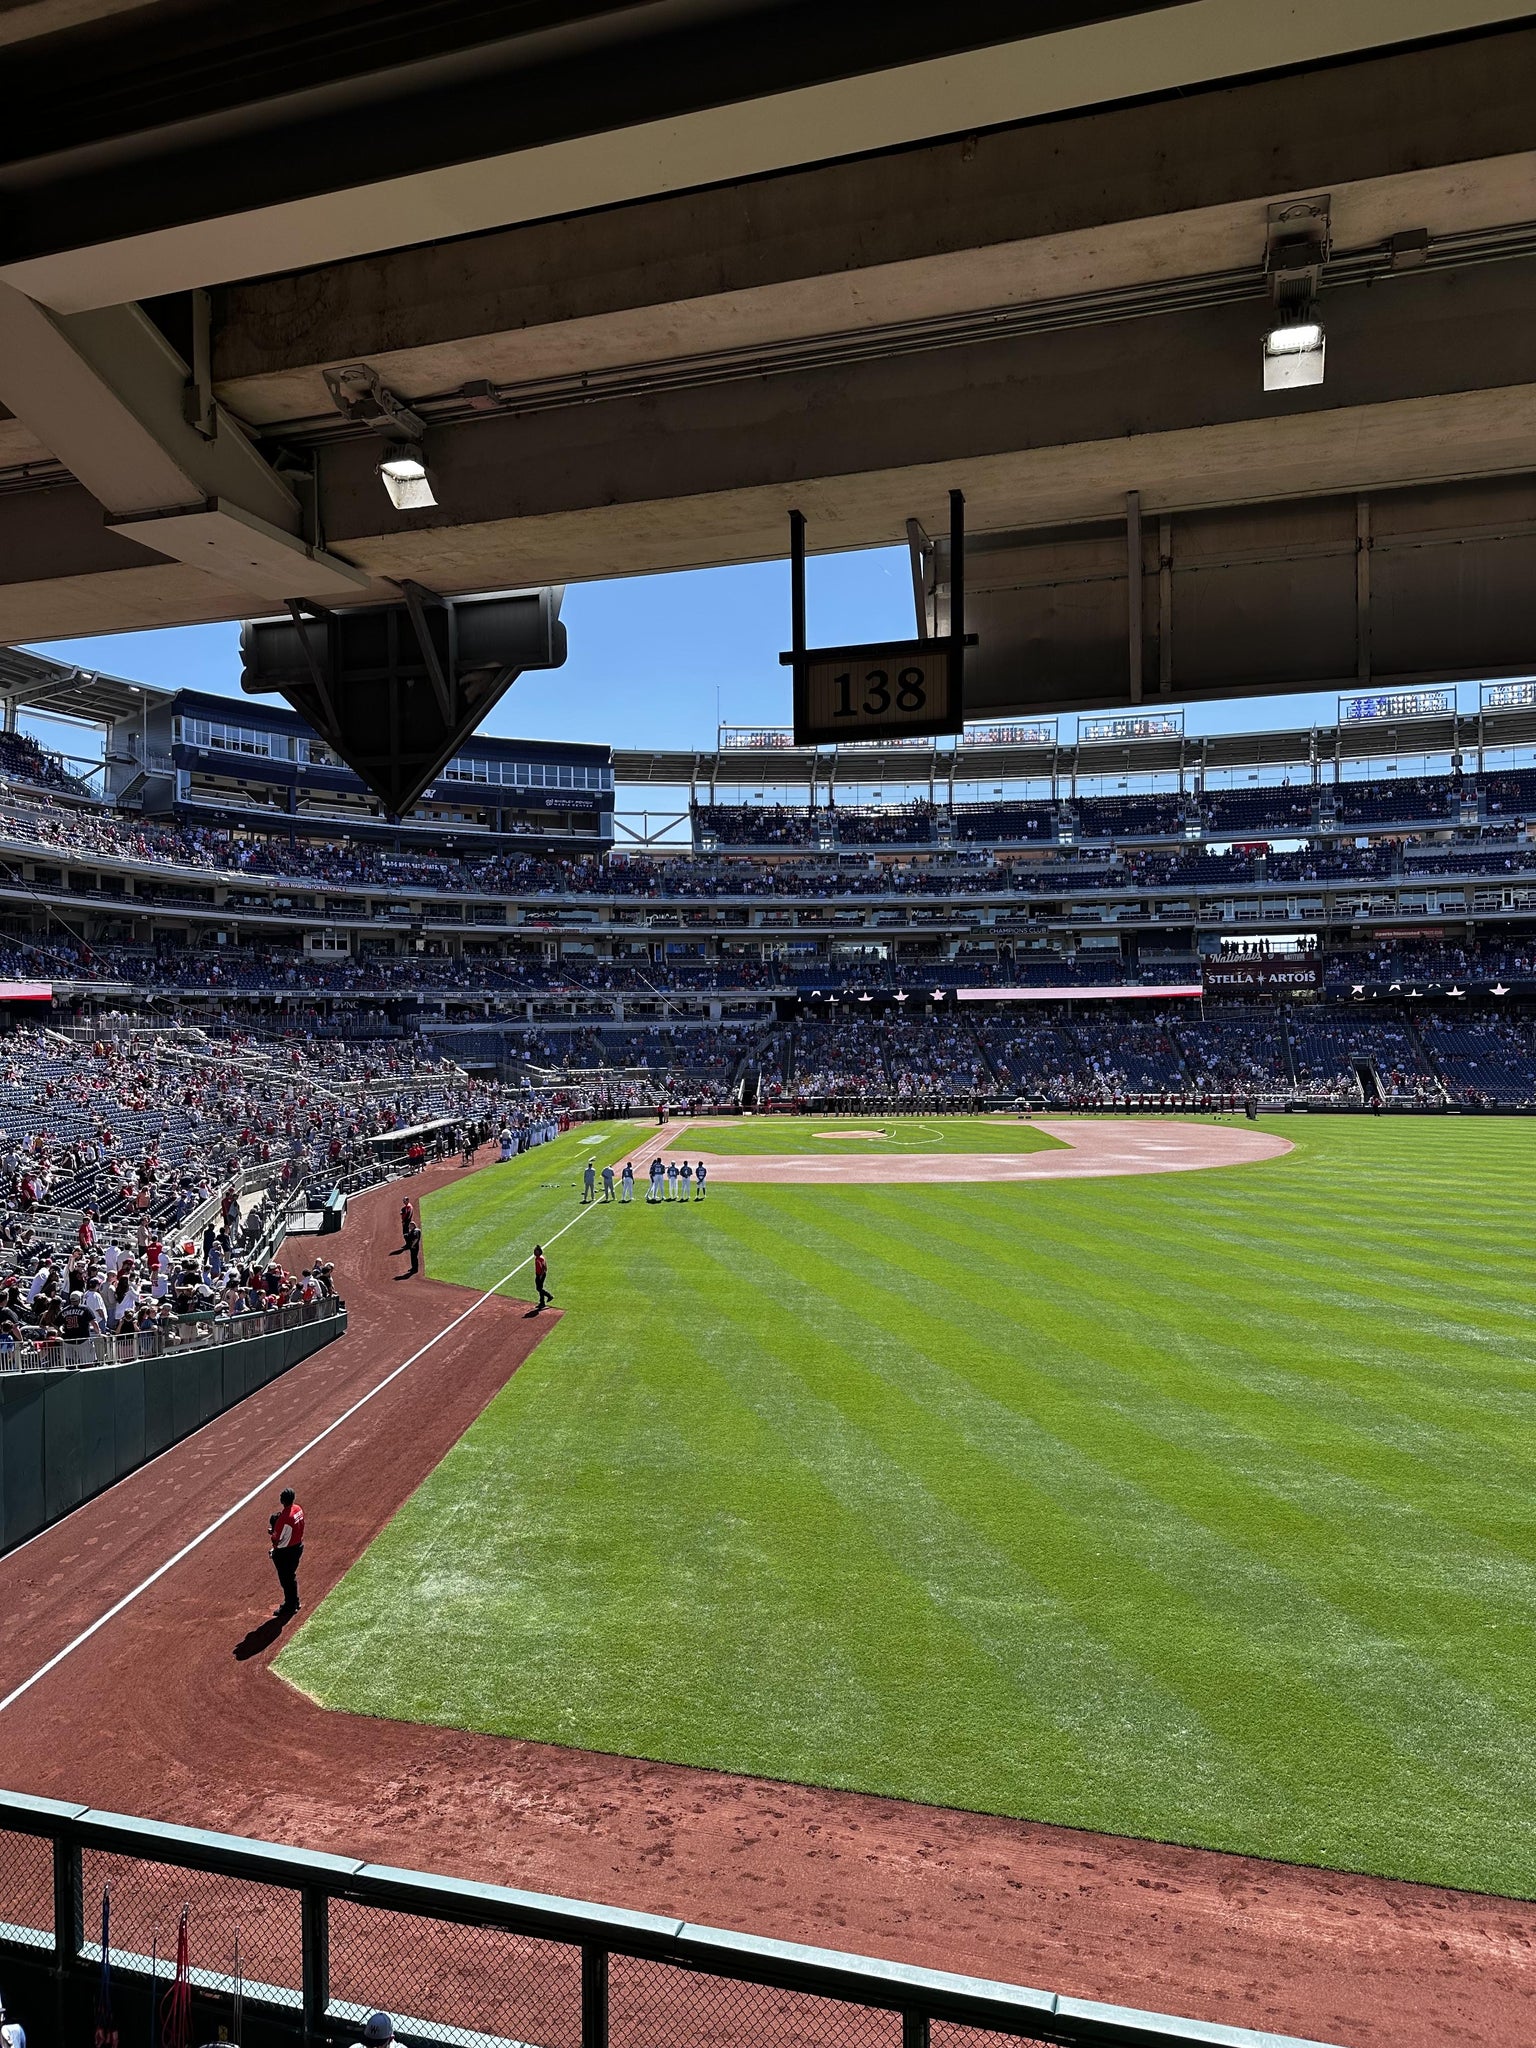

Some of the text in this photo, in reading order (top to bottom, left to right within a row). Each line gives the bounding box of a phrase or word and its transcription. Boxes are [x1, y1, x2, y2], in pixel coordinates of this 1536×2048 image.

[833, 667, 926, 717] 138
[1210, 952, 1262, 963] Nationals
[1208, 973, 1316, 984] STELLA ARTOIS
[340, 1000, 360, 1009] PNC
[65, 1315, 80, 1329] 31
